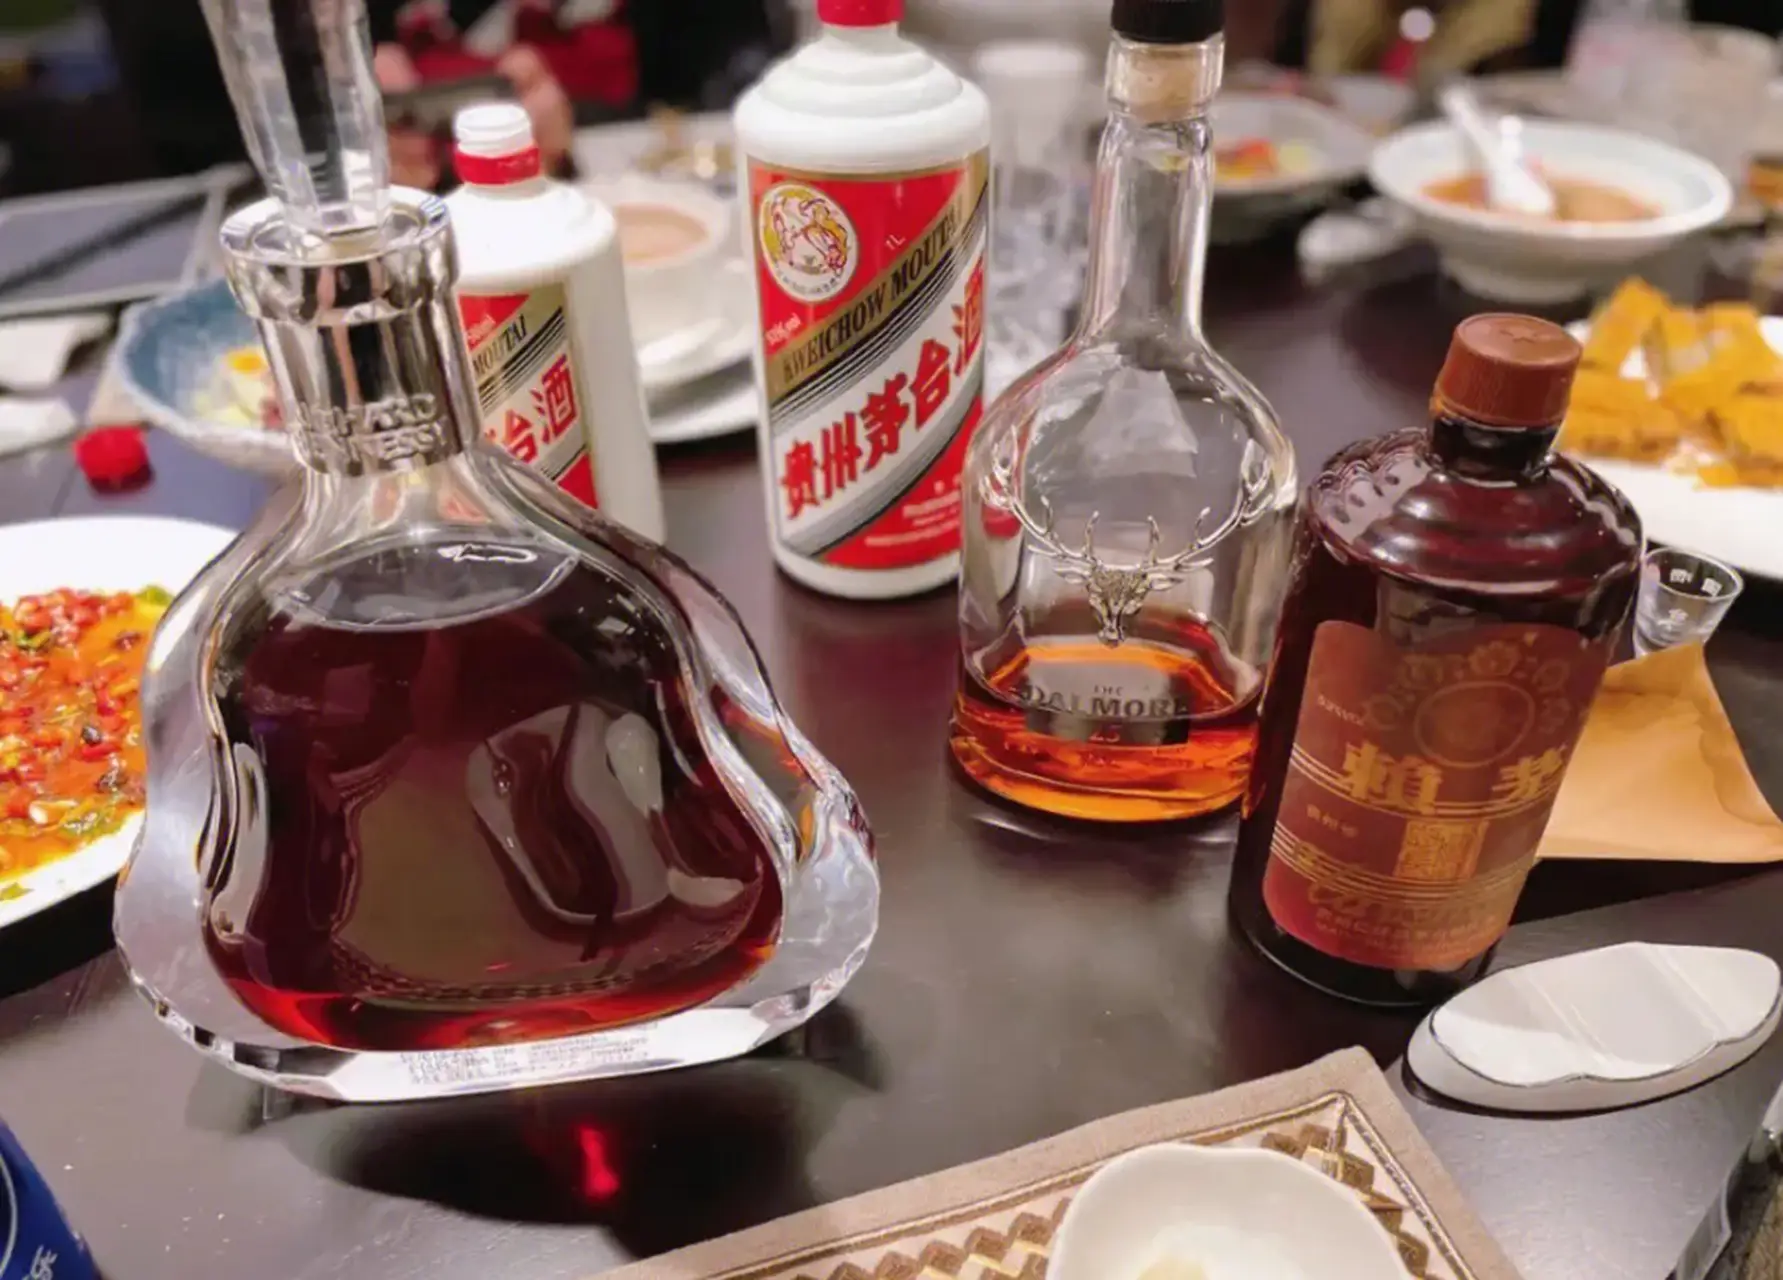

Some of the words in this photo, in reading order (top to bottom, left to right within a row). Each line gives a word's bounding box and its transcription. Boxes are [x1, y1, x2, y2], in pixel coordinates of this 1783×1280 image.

[472, 313, 528, 377] MOUTAI
[783, 281, 887, 383] KWEICHOW
[484, 353, 578, 464] 台酒
[780, 252, 984, 520] 贵州茅台酒
